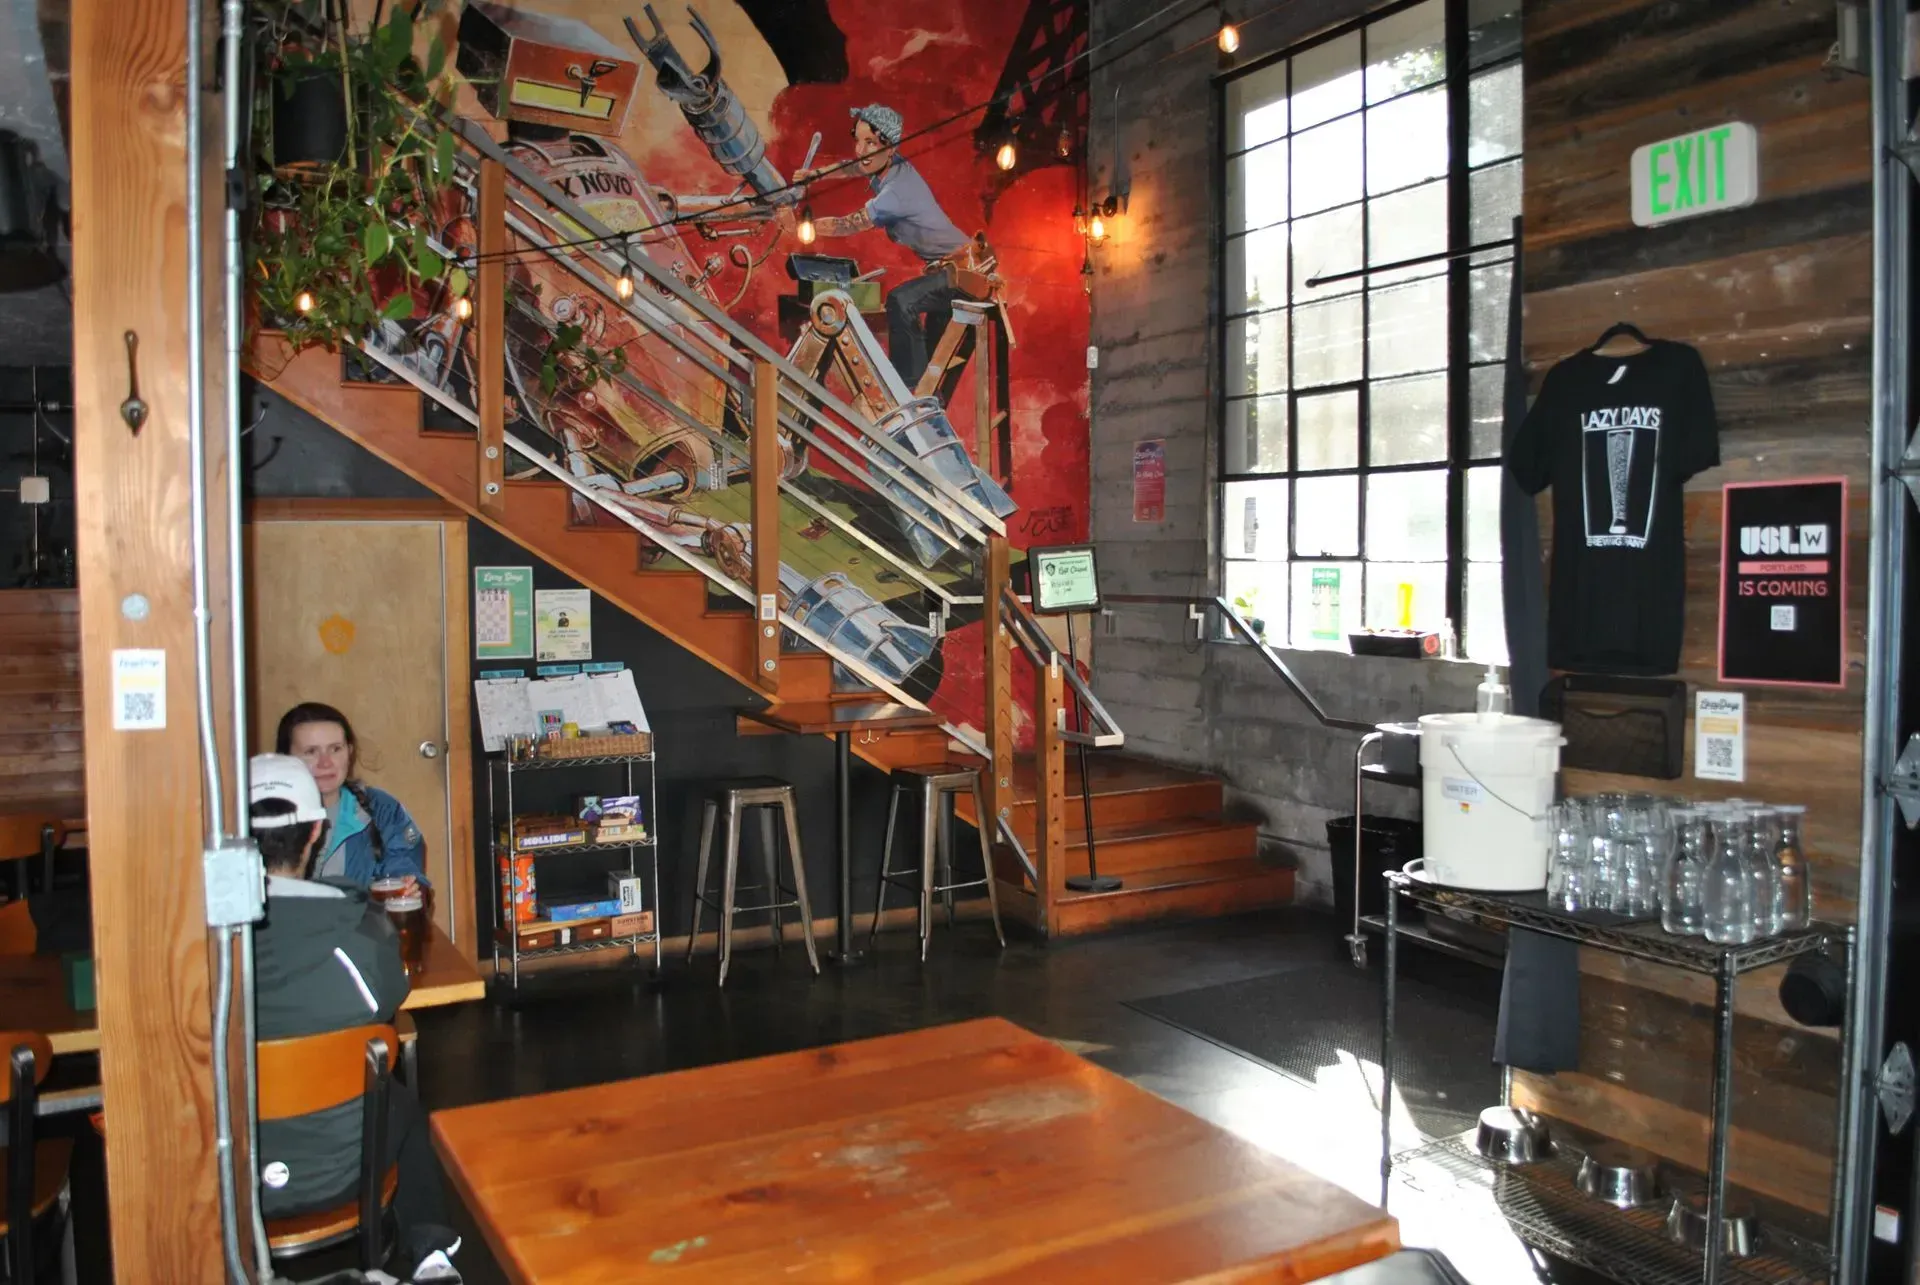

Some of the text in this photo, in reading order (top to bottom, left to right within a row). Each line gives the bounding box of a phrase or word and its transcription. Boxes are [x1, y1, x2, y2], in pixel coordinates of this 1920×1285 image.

[1650, 127, 1731, 216] EXIT
[578, 172, 633, 196] NOVO
[1581, 406, 1661, 431] LAZY DAYS
[1740, 525, 1800, 555] USL
[1738, 580, 1828, 597] IS COMING
[1446, 785, 1478, 796] WATER
